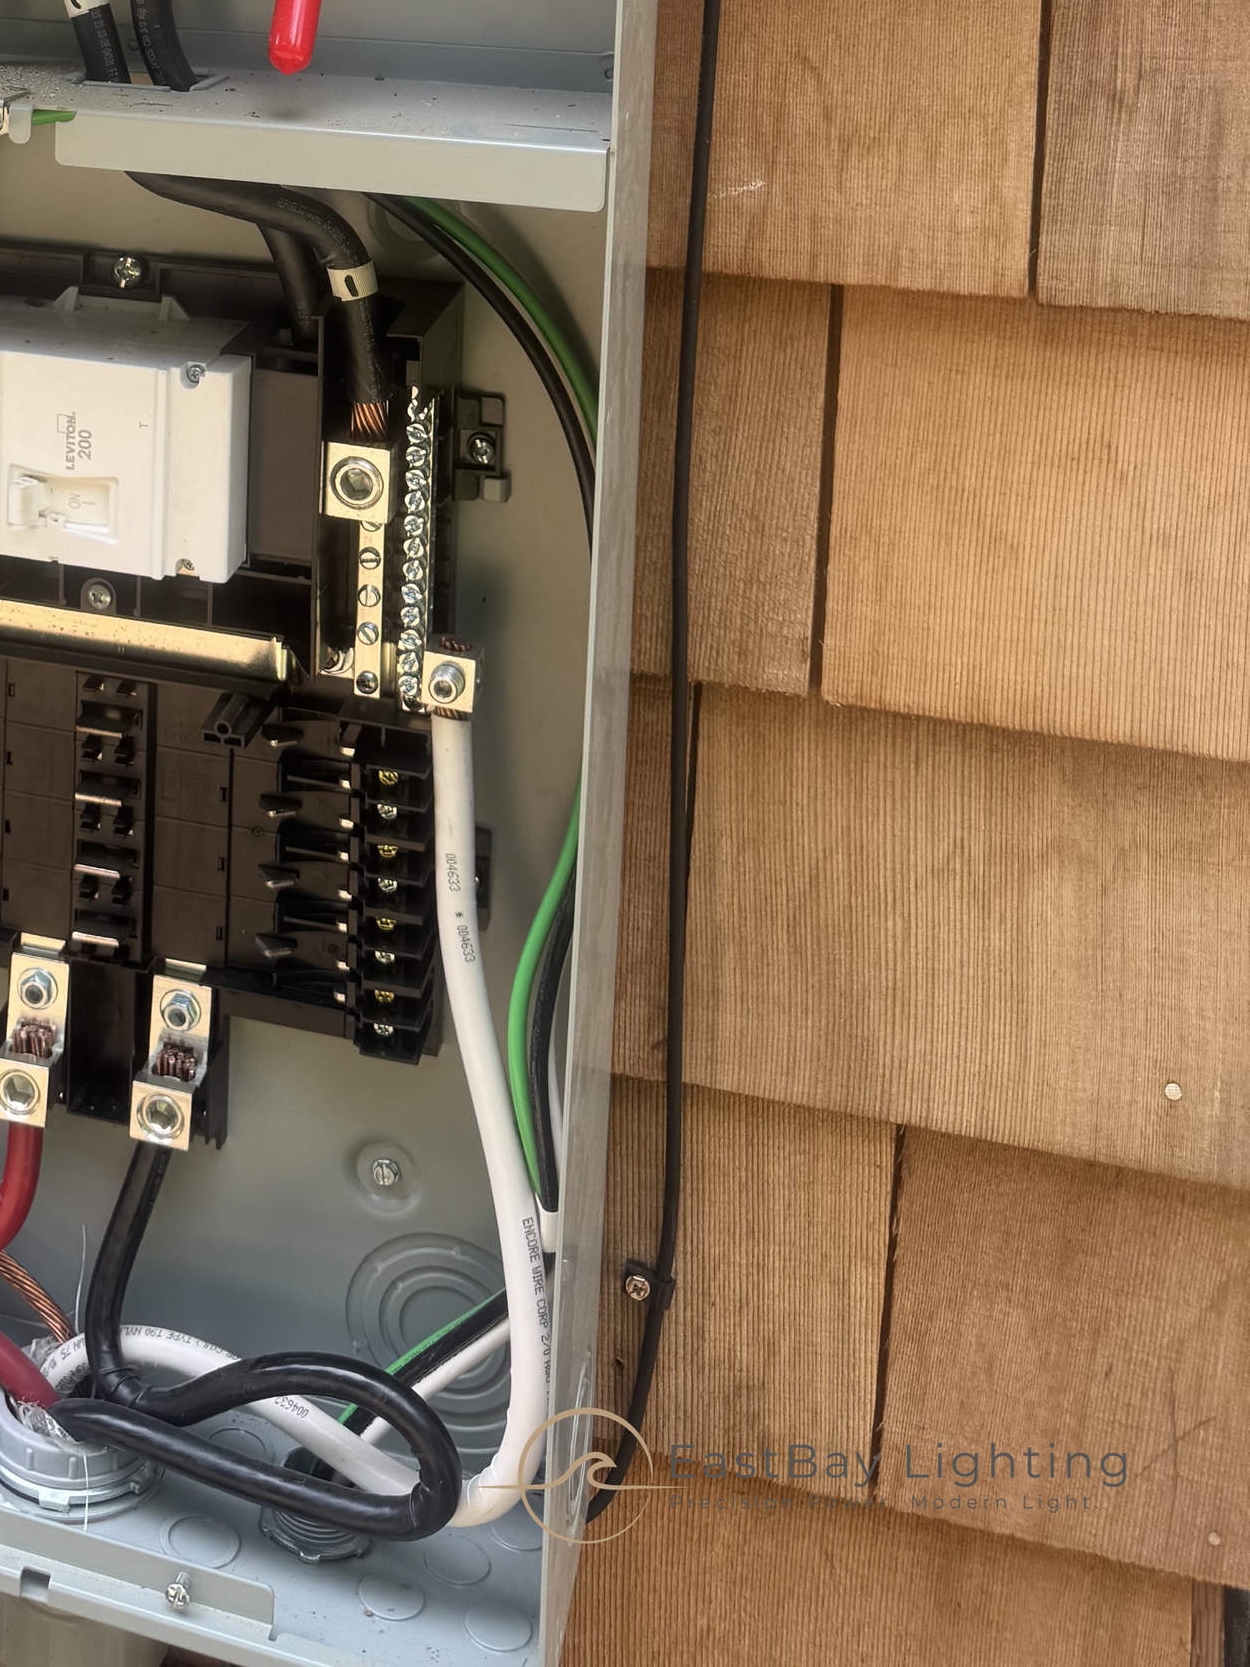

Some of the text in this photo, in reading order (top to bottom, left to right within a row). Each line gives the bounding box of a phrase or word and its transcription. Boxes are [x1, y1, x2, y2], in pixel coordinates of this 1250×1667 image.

[65, 414, 76, 470] LEVITON
[78, 429, 92, 460] 200
[68, 493, 81, 509] ON
[445, 853, 475, 963] 004633 004633
[522, 1217, 541, 1262] ENCORE
[532, 1265, 545, 1295] WIRE
[537, 1298, 550, 1328] CORP
[144, 1328, 162, 1338] T90
[166, 1330, 192, 1344] TYPE
[541, 1333, 550, 1356] 2/0
